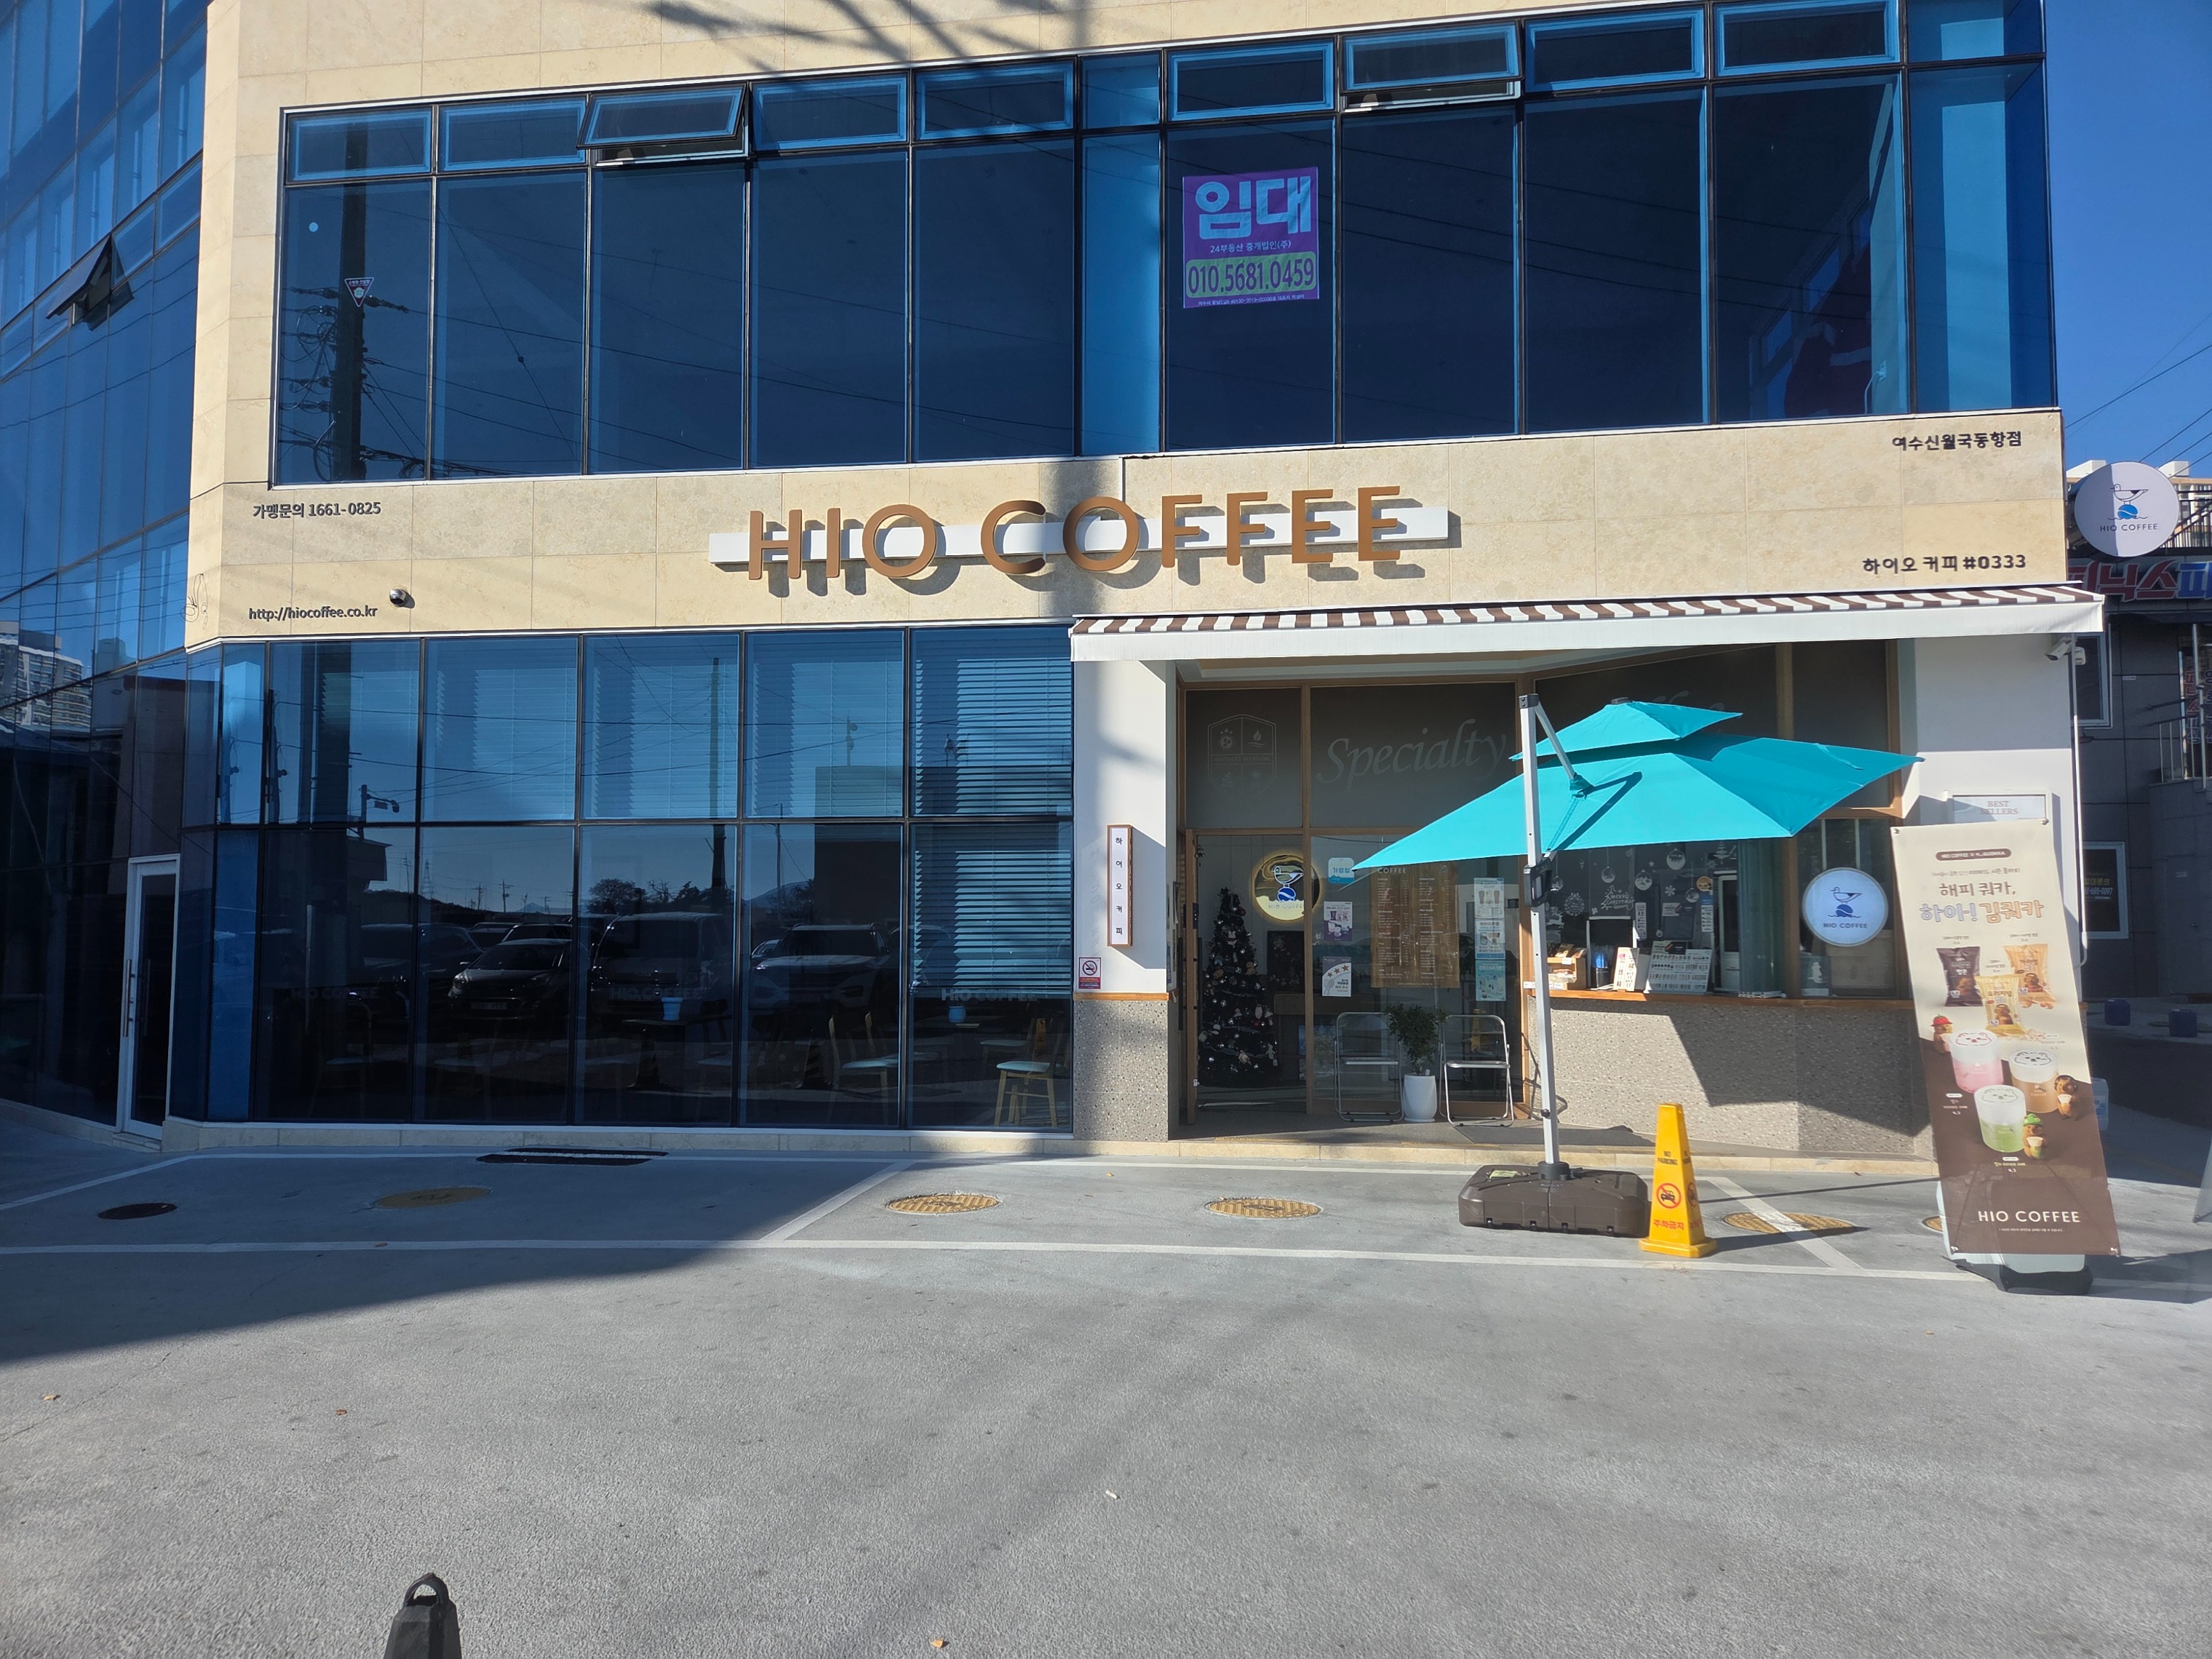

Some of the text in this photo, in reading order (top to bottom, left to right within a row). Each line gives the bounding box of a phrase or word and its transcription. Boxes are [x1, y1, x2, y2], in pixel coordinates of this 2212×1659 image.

[1195, 176, 1311, 239] 임대
[1210, 240, 1292, 253] 24부동산 중개법인(주)
[1188, 258, 1314, 294] 010.5681.0459
[1892, 431, 2021, 451] 여수신월국동항점
[252, 501, 381, 519] 가맹문의 1661-0825
[749, 485, 1401, 580] HIO COFFEE
[2121, 523, 2158, 531] COFFEE
[1862, 554, 2026, 575] 하이오 커피 #0333
[249, 605, 378, 622] http://hiocoffee.co.kr
[1316, 718, 1508, 791] Specialty
[1938, 881, 2016, 897] 해피 쿼카,
[1978, 899, 2045, 923] 김쿼카
[1654, 1219, 1684, 1231] 주차금지
[1978, 1211, 2081, 1222] HIO COFFEE
